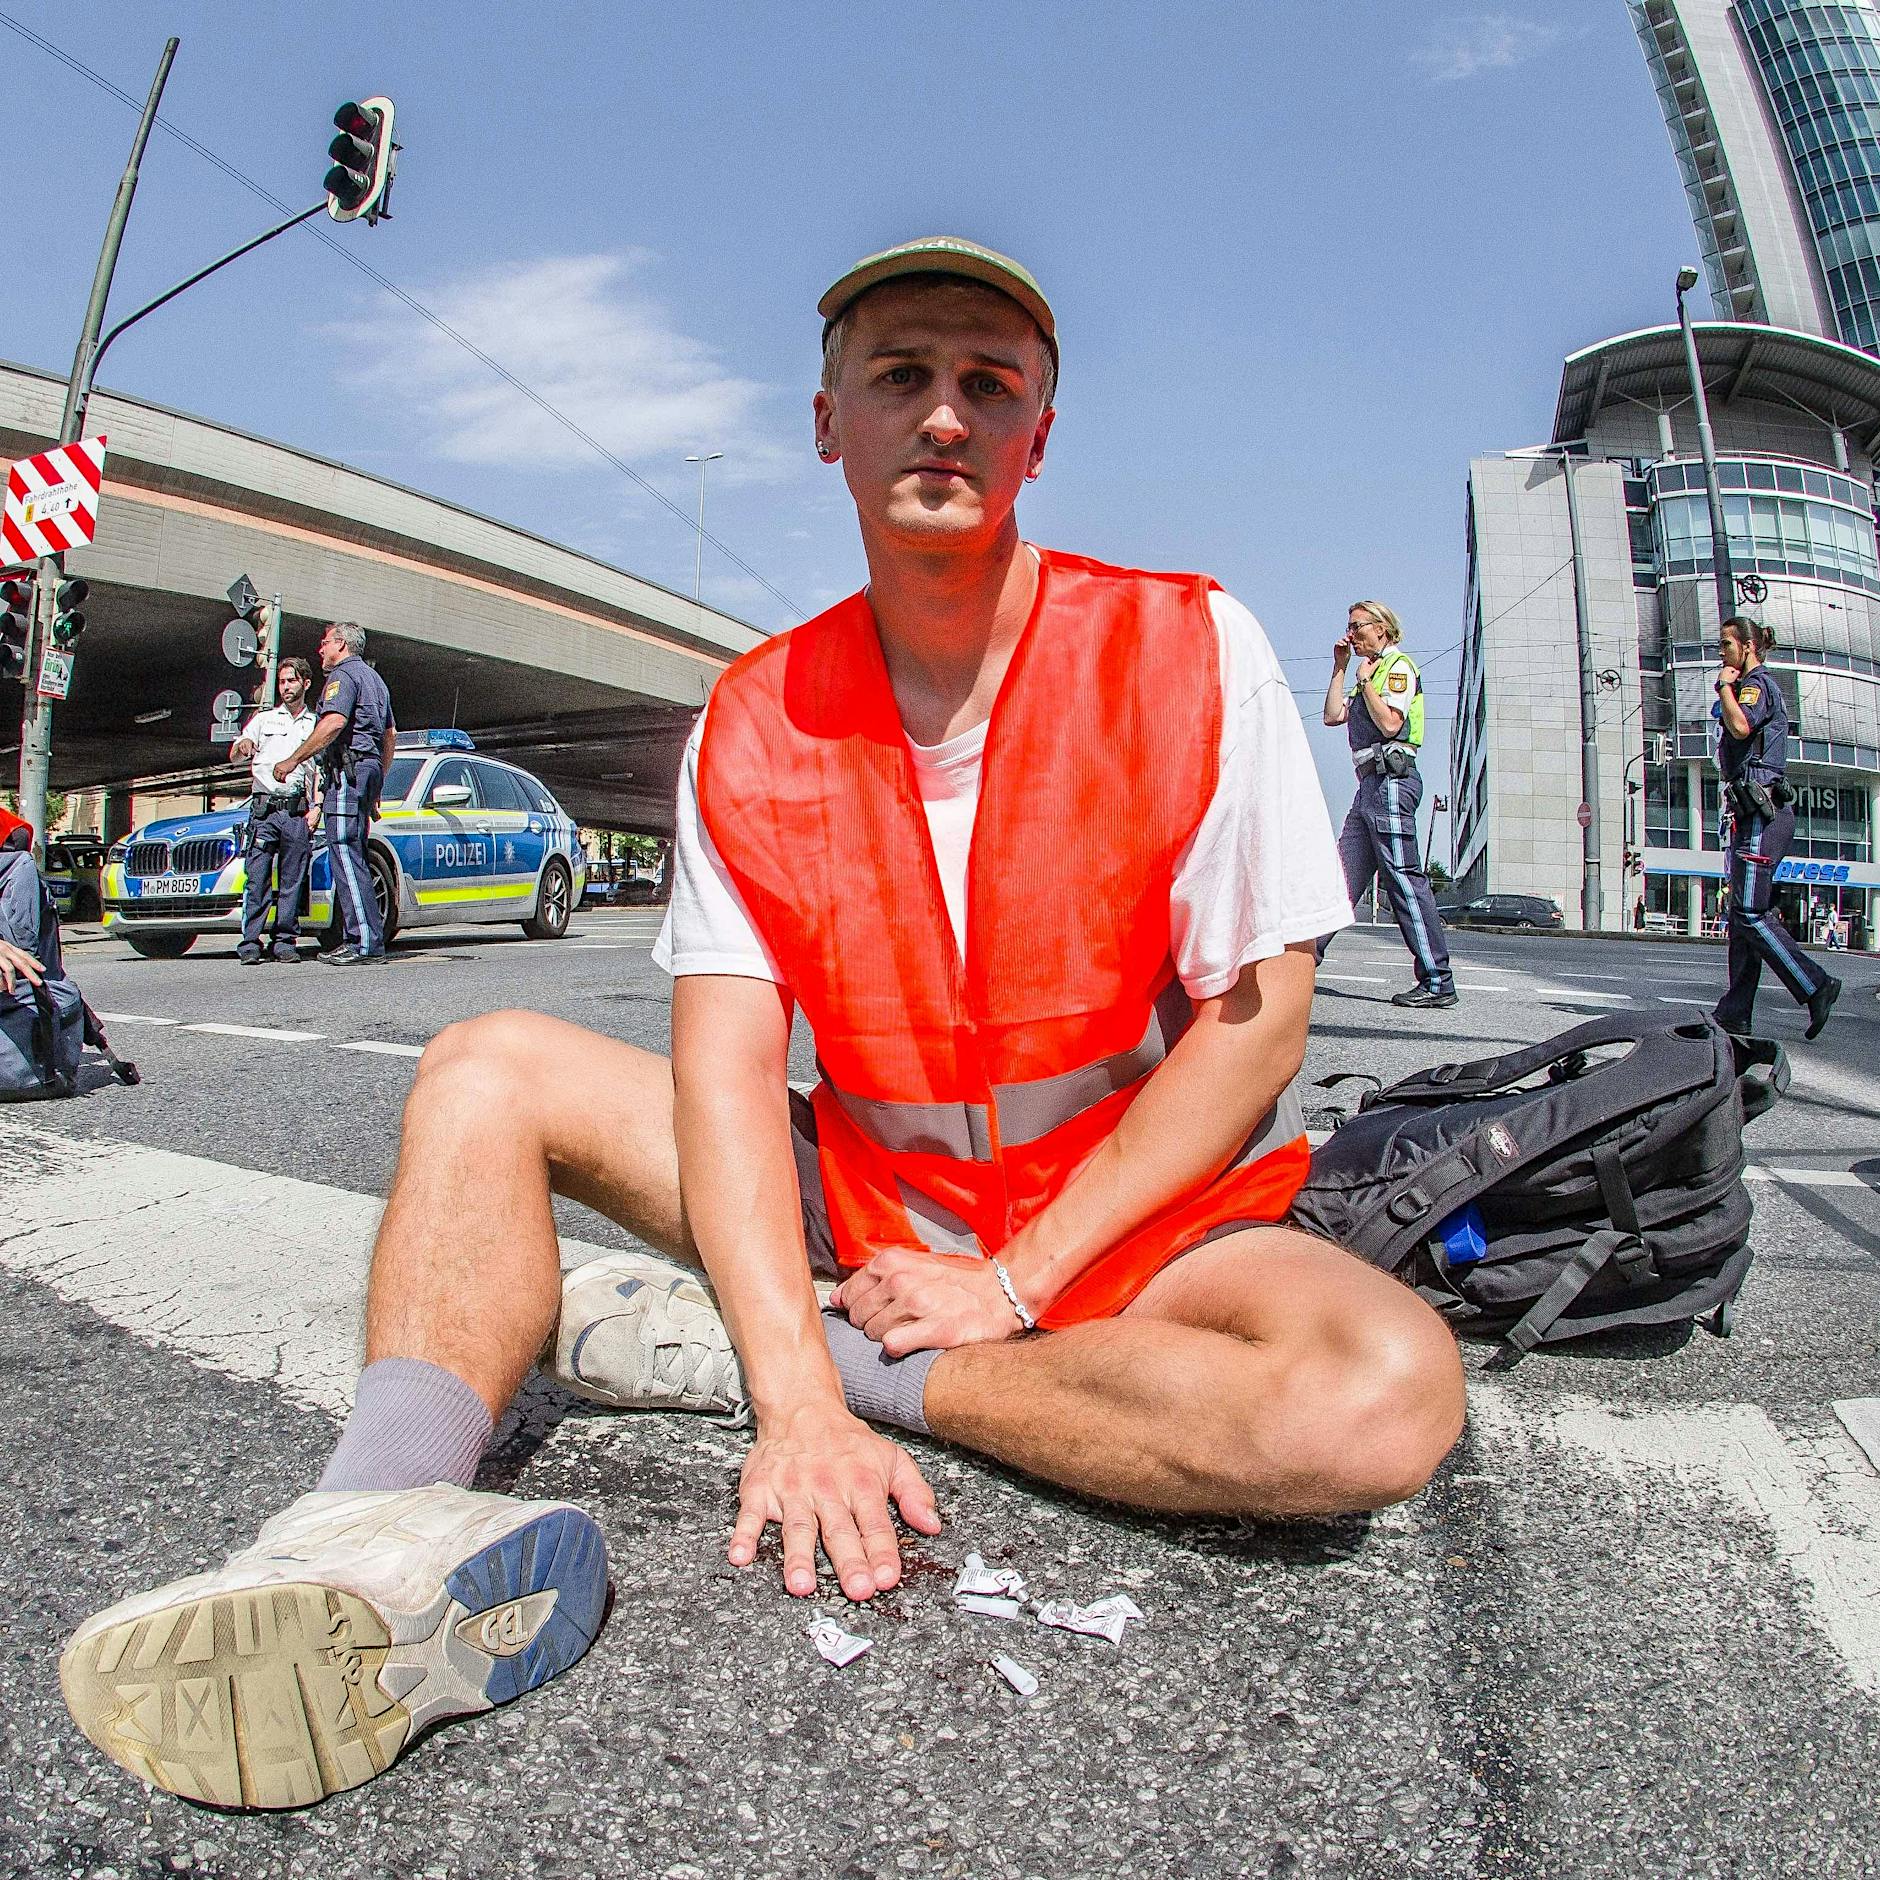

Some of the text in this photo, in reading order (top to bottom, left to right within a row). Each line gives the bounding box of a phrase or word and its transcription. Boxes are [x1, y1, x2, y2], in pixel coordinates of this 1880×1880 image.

[435, 842, 487, 867] POLIZEI
[171, 878, 199, 893] 8059
[481, 1604, 529, 1650] GEL
